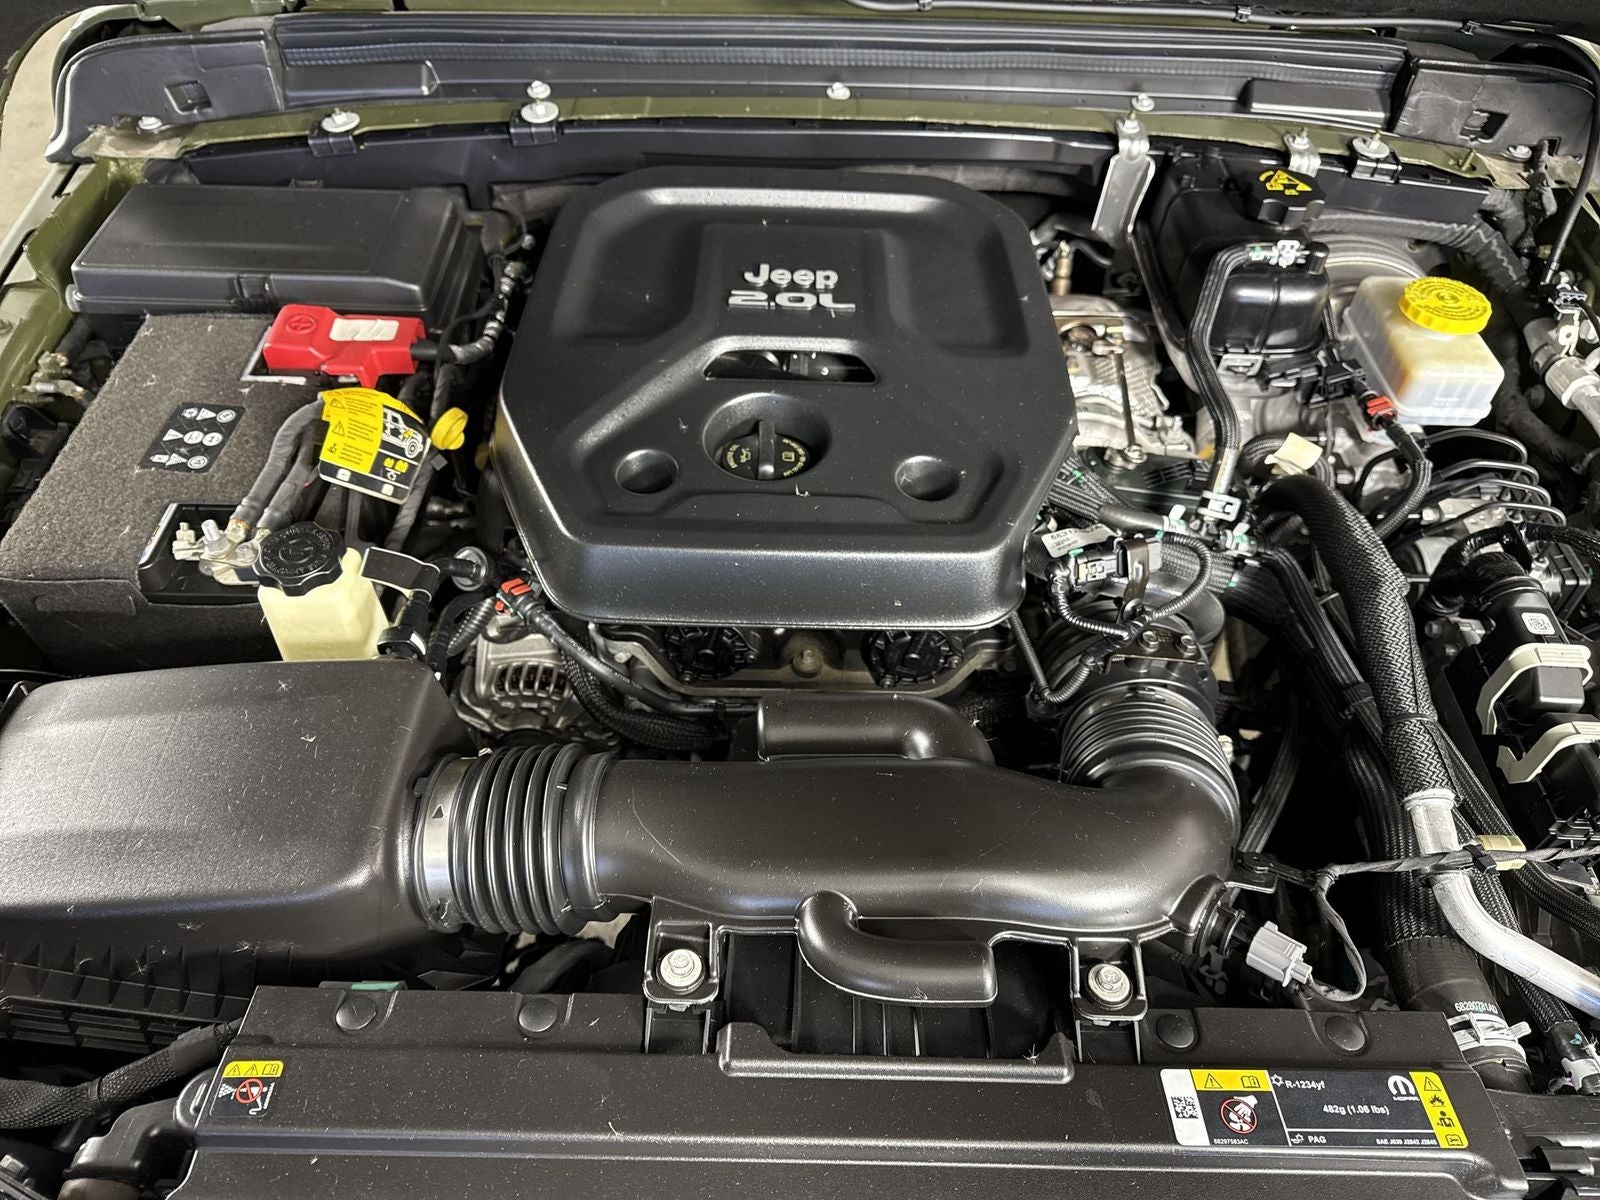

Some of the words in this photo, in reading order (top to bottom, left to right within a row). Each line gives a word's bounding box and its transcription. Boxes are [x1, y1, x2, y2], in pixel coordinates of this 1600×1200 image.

[743, 263, 839, 290] Jeep
[727, 290, 856, 312] 2.0L
[1284, 1080, 1326, 1091] R-1234yf
[1322, 1104, 1347, 1116] 482g
[1370, 1104, 1390, 1116] lbs)
[1307, 1135, 1327, 1144] PAG
